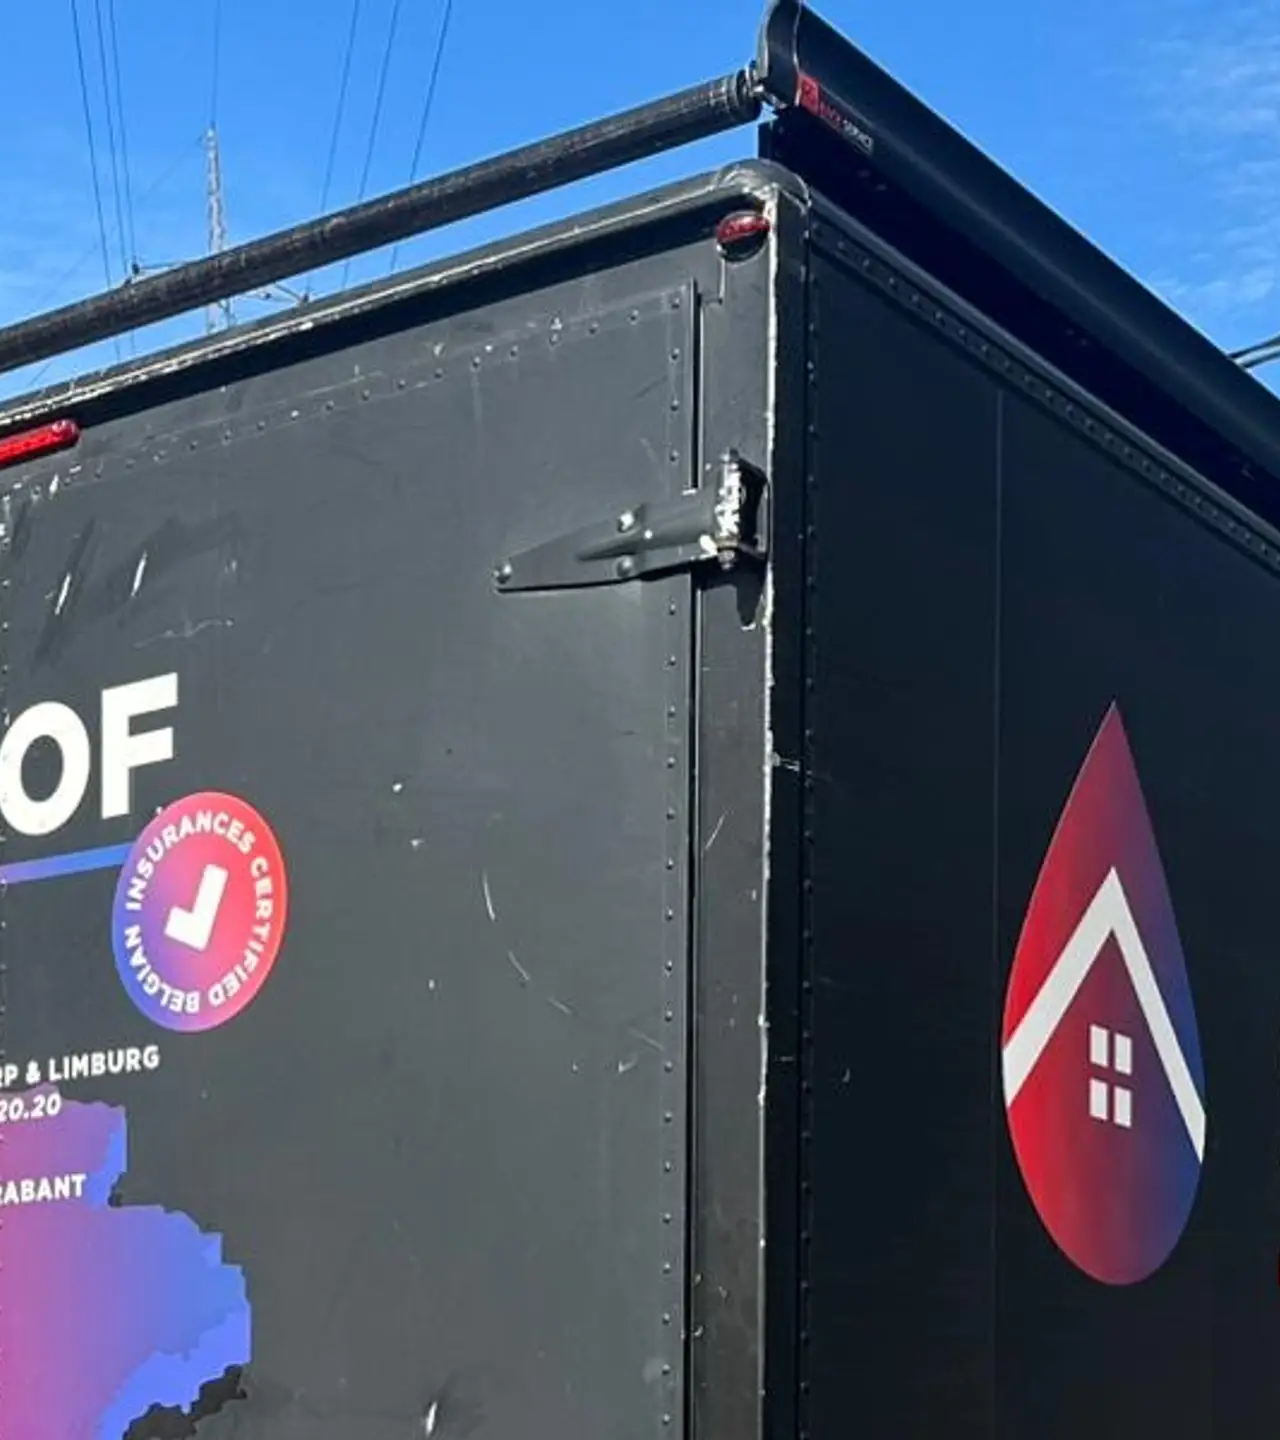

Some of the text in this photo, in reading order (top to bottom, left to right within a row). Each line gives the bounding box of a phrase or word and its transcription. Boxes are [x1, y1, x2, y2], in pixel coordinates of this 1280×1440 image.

[124, 810, 274, 1013] INSURANCES CERTIFIED BELGIAN
[25, 1061, 41, 1083] &
[49, 1045, 160, 1082] LIMBURG
